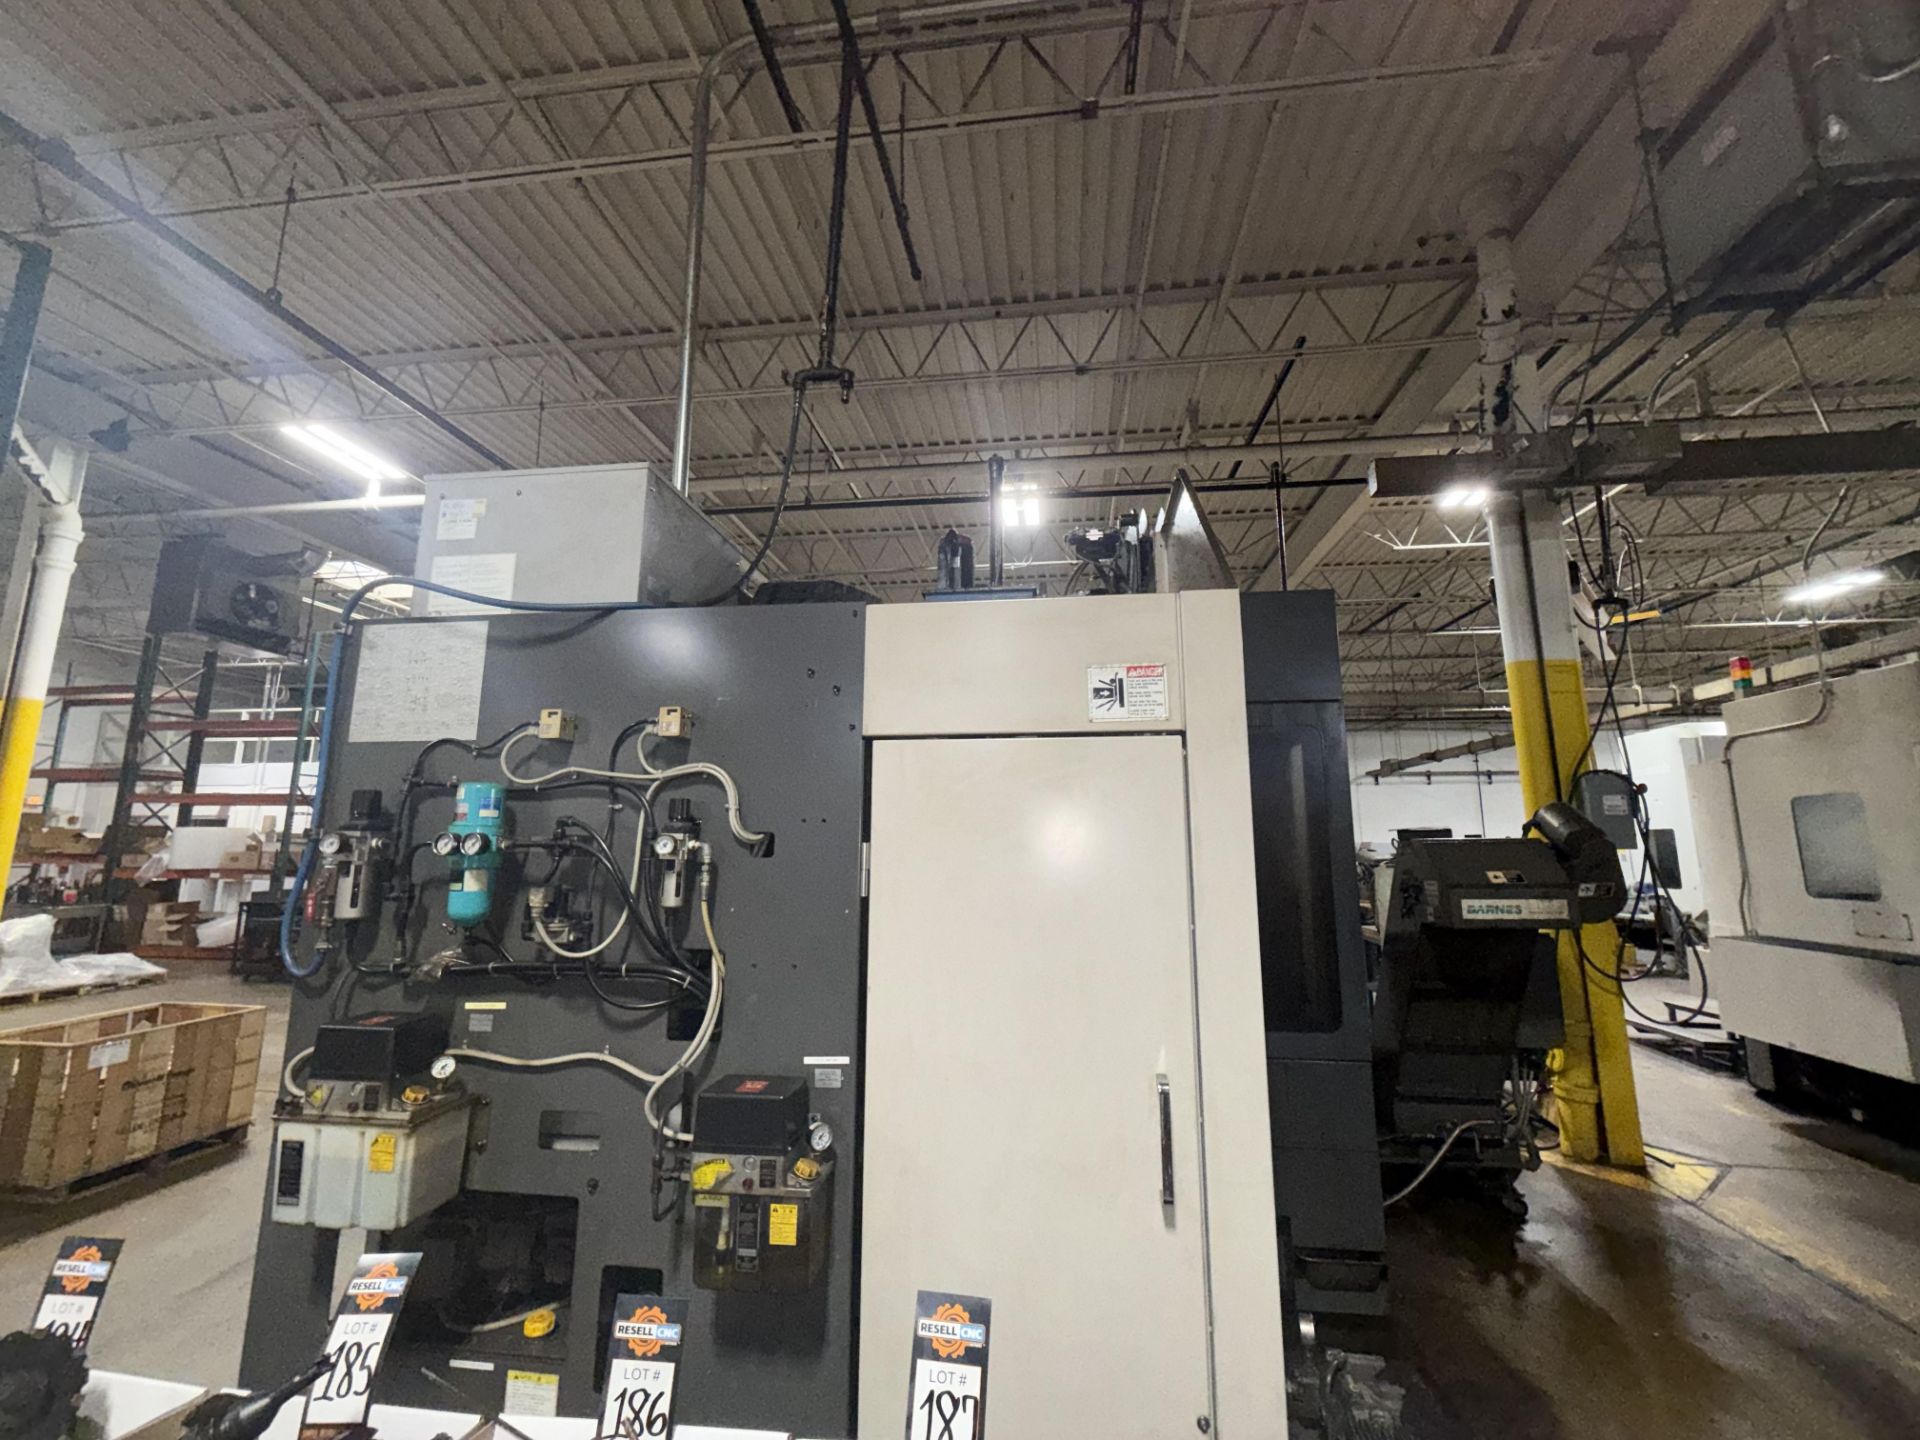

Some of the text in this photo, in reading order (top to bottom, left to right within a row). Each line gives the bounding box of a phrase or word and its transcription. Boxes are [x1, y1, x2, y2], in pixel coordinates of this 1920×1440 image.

[1466, 904, 1523, 915] BARNES
[56, 1263, 87, 1273] RESELL
[351, 1280, 383, 1291] RESELL
[50, 1302, 75, 1315] LOT
[343, 1321, 378, 1335] LOT #
[617, 1325, 679, 1339] RESELL CNC
[920, 1322, 983, 1340] RESELL CNC
[313, 1340, 381, 1401] 185
[623, 1367, 661, 1381] LOT #
[928, 1368, 967, 1386] LOT #
[602, 1386, 668, 1439] 186
[920, 1388, 979, 1440] 187
